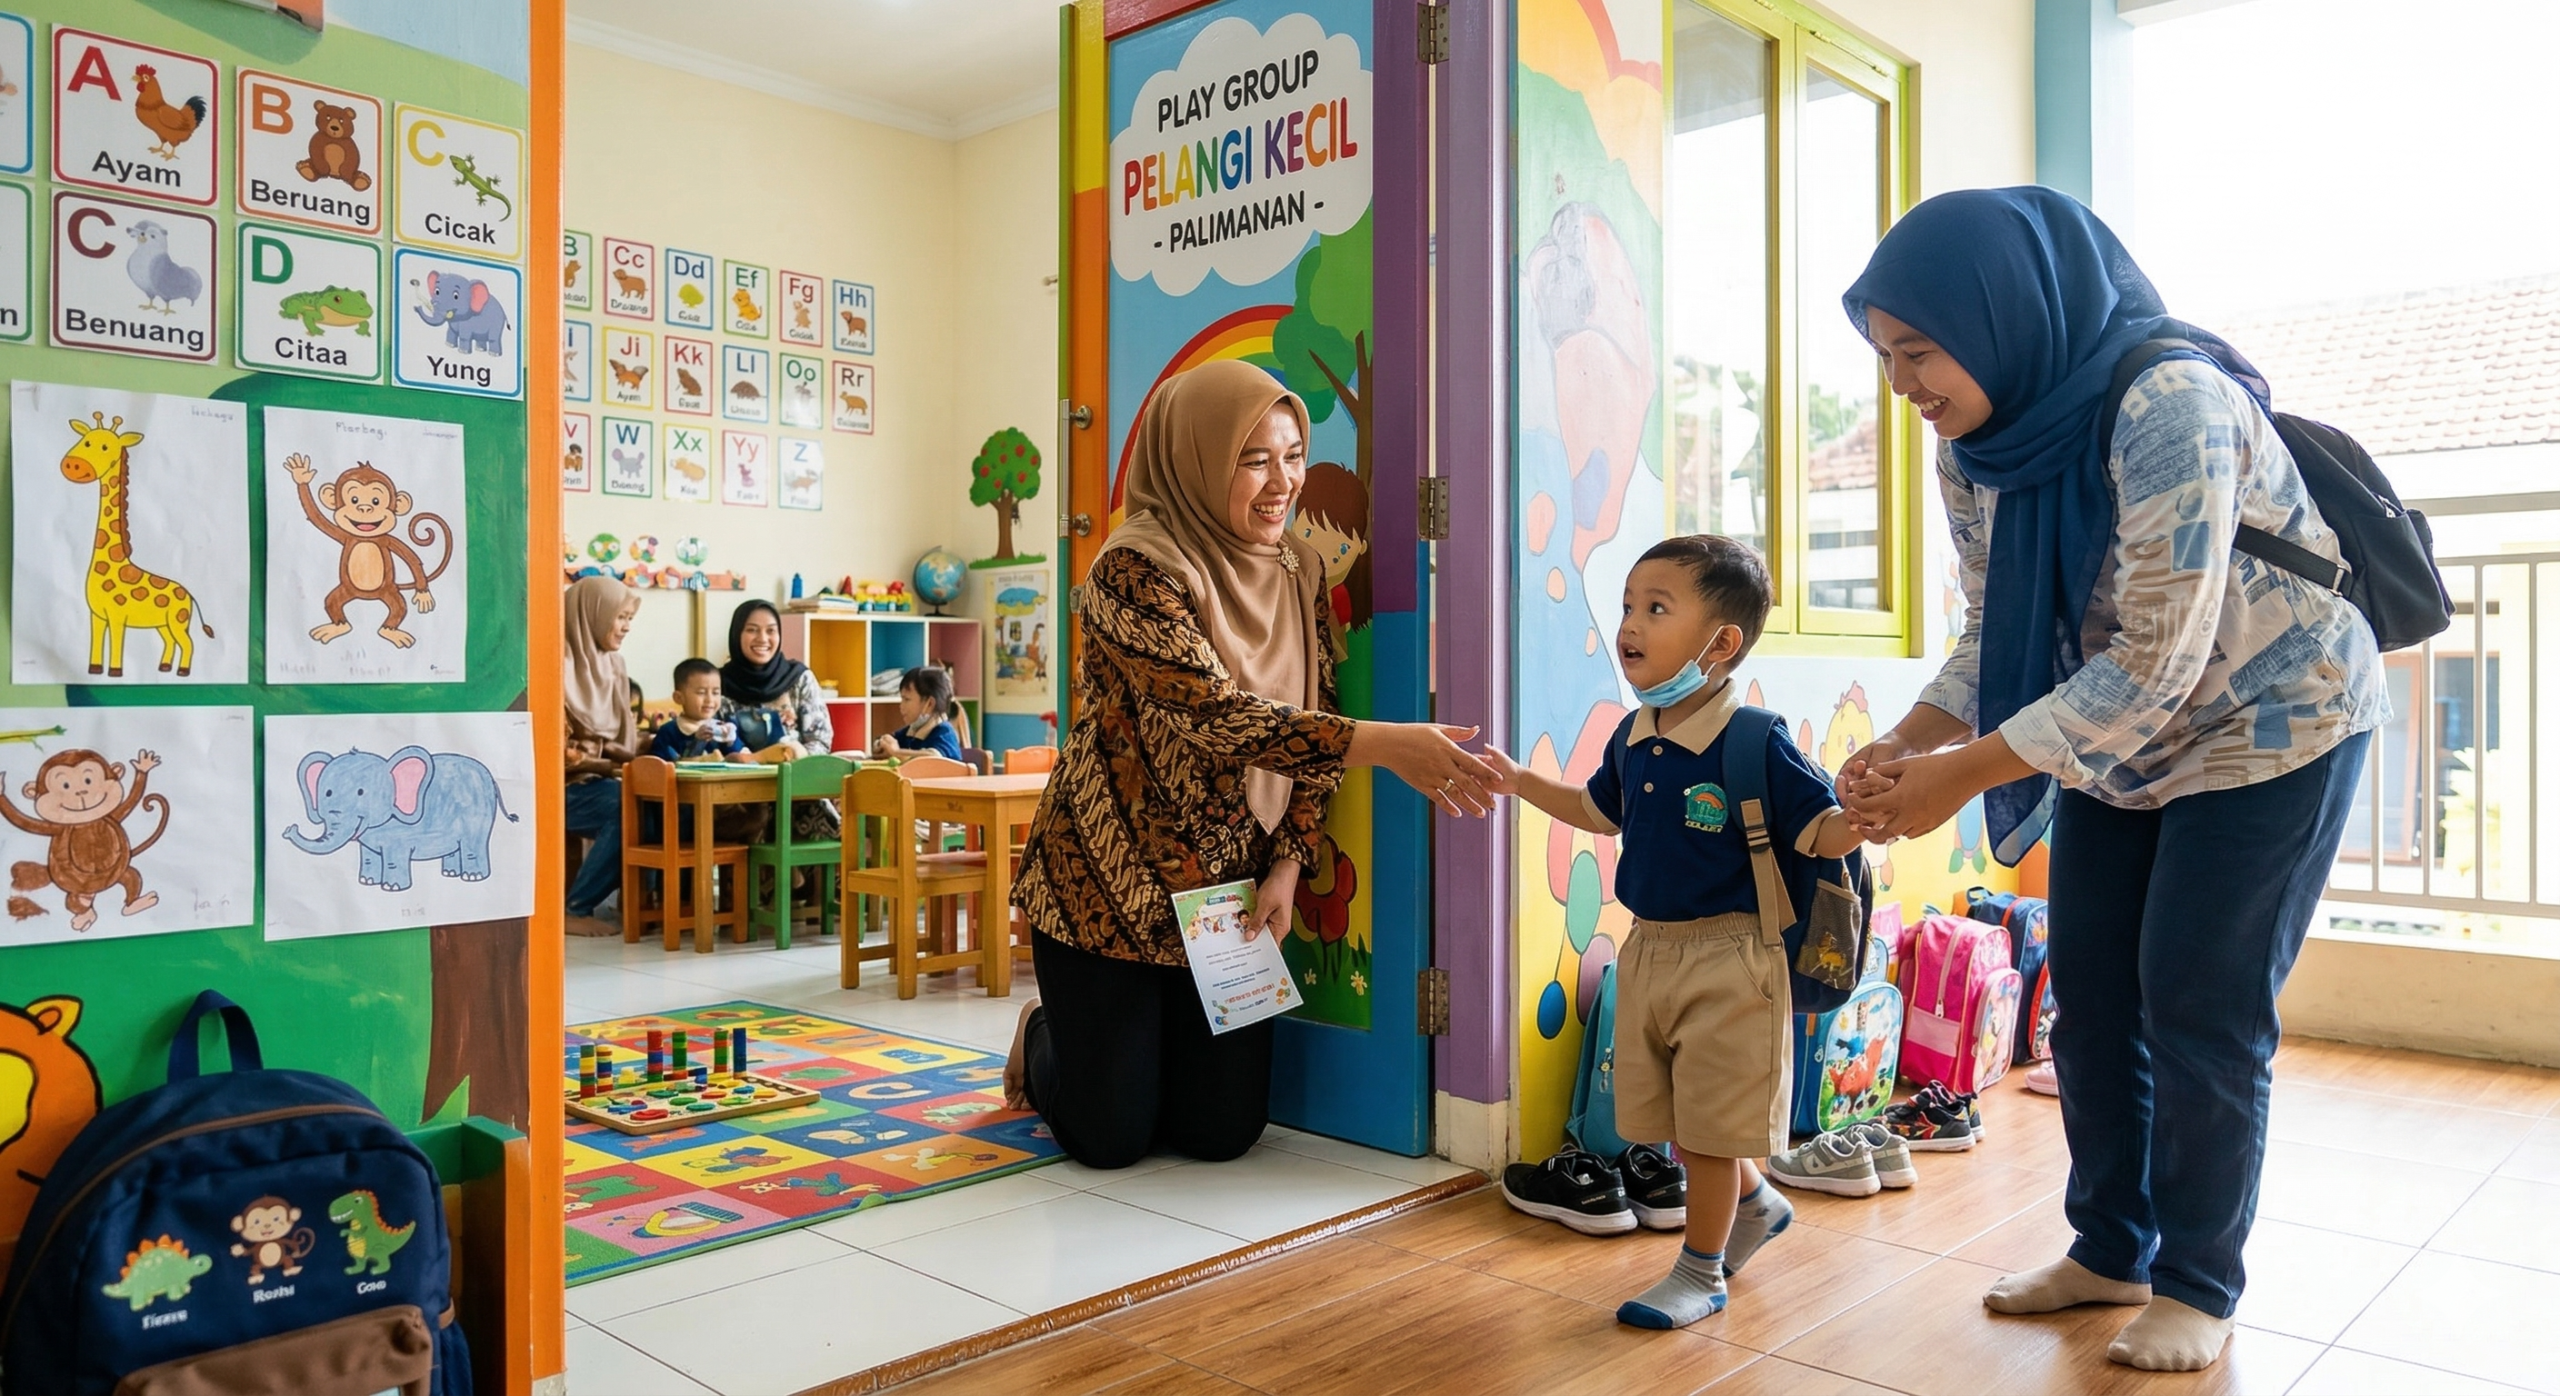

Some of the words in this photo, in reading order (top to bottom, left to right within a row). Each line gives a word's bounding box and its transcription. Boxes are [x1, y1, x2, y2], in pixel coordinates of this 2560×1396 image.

[67, 45, 122, 102] A
[1158, 82, 1216, 133] PLAY
[1223, 49, 1319, 111] GROUP
[251, 82, 294, 135] B
[406, 119, 446, 167] C
[1124, 125, 1252, 216] PELANGI
[1265, 96, 1358, 179] KECIL
[91, 150, 182, 187] Ayam
[251, 179, 371, 225] Beruang
[66, 207, 116, 259] C
[424, 213, 496, 244] Cicak
[1170, 190, 1305, 253] PALIMANAN
[251, 234, 294, 285] D
[614, 246, 644, 268] Cc
[675, 256, 704, 279] Dd
[736, 267, 758, 288] Ef
[790, 278, 813, 303] Fg
[840, 286, 866, 308] Hh
[65, 308, 204, 351] Benuang
[274, 336, 348, 366] Citaa
[620, 336, 640, 356] Ji
[675, 343, 703, 365] Kk
[427, 355, 492, 387] Yung
[787, 360, 816, 381] Oo
[842, 367, 864, 387] Rr
[616, 424, 640, 445] W
[674, 430, 702, 452] Xx
[732, 436, 759, 462] Yy
[794, 443, 808, 462] Z
